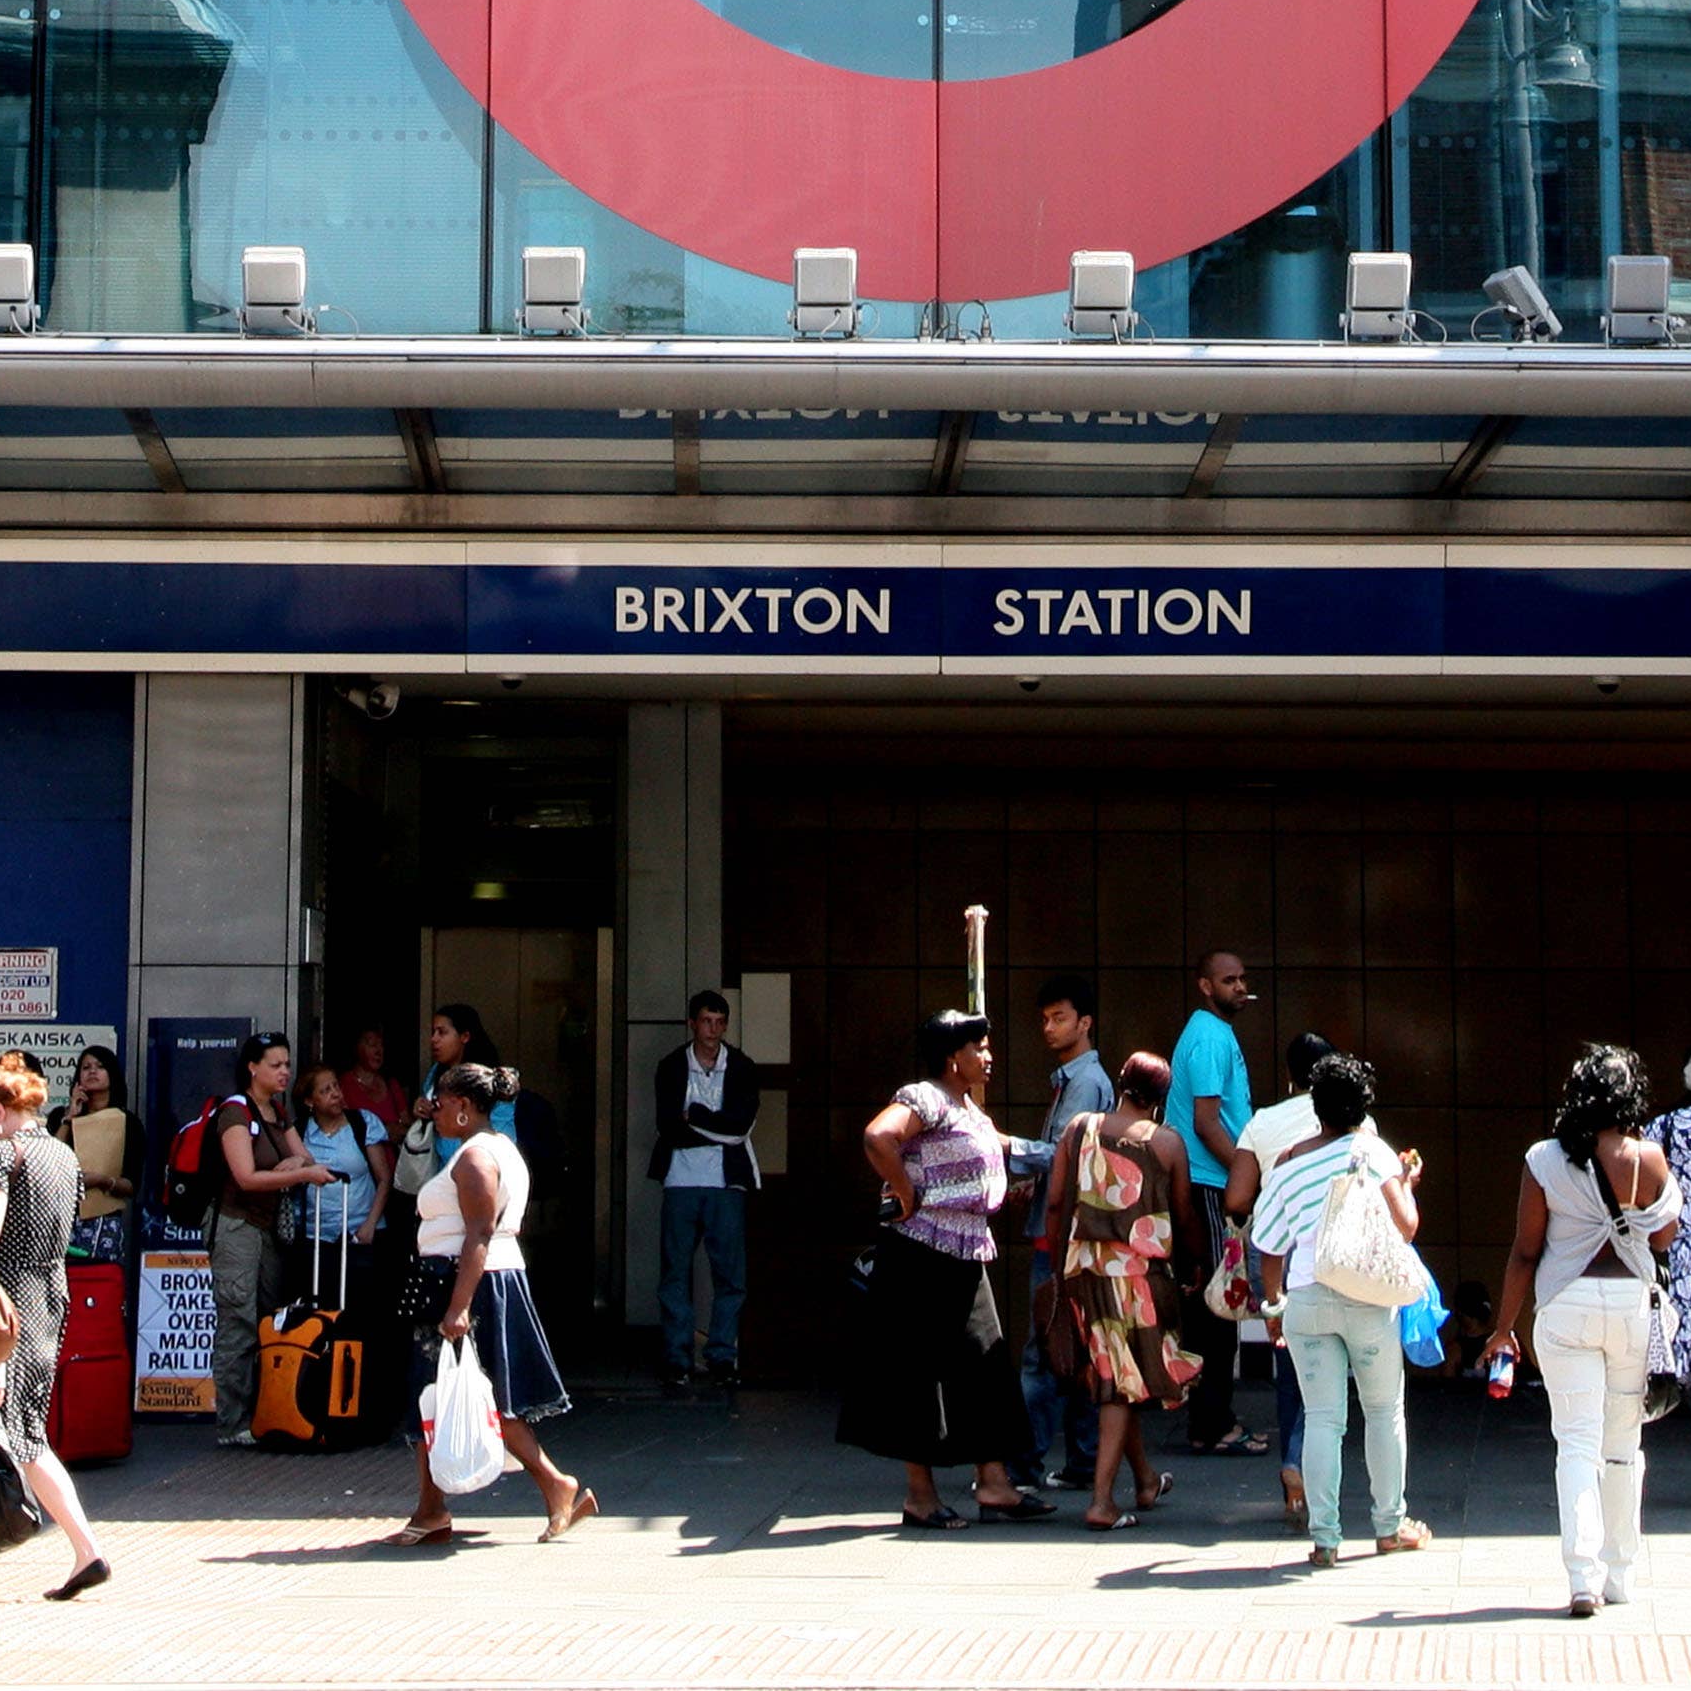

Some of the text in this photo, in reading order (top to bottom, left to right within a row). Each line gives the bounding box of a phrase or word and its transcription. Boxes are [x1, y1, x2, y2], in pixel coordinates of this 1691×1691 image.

[614, 586, 1252, 635] BRIXTON STATION
[0, 989, 25, 1001] 020
[18, 1002, 49, 1013] 0861
[177, 1038, 238, 1050] Help yourself
[160, 1273, 214, 1291] BROW
[166, 1293, 214, 1310] TAKE
[168, 1313, 216, 1330] OVER
[159, 1332, 215, 1350] MAJO
[149, 1352, 214, 1369] RAIL LI
[140, 1383, 196, 1397] Evening
[139, 1395, 201, 1408] Standard
